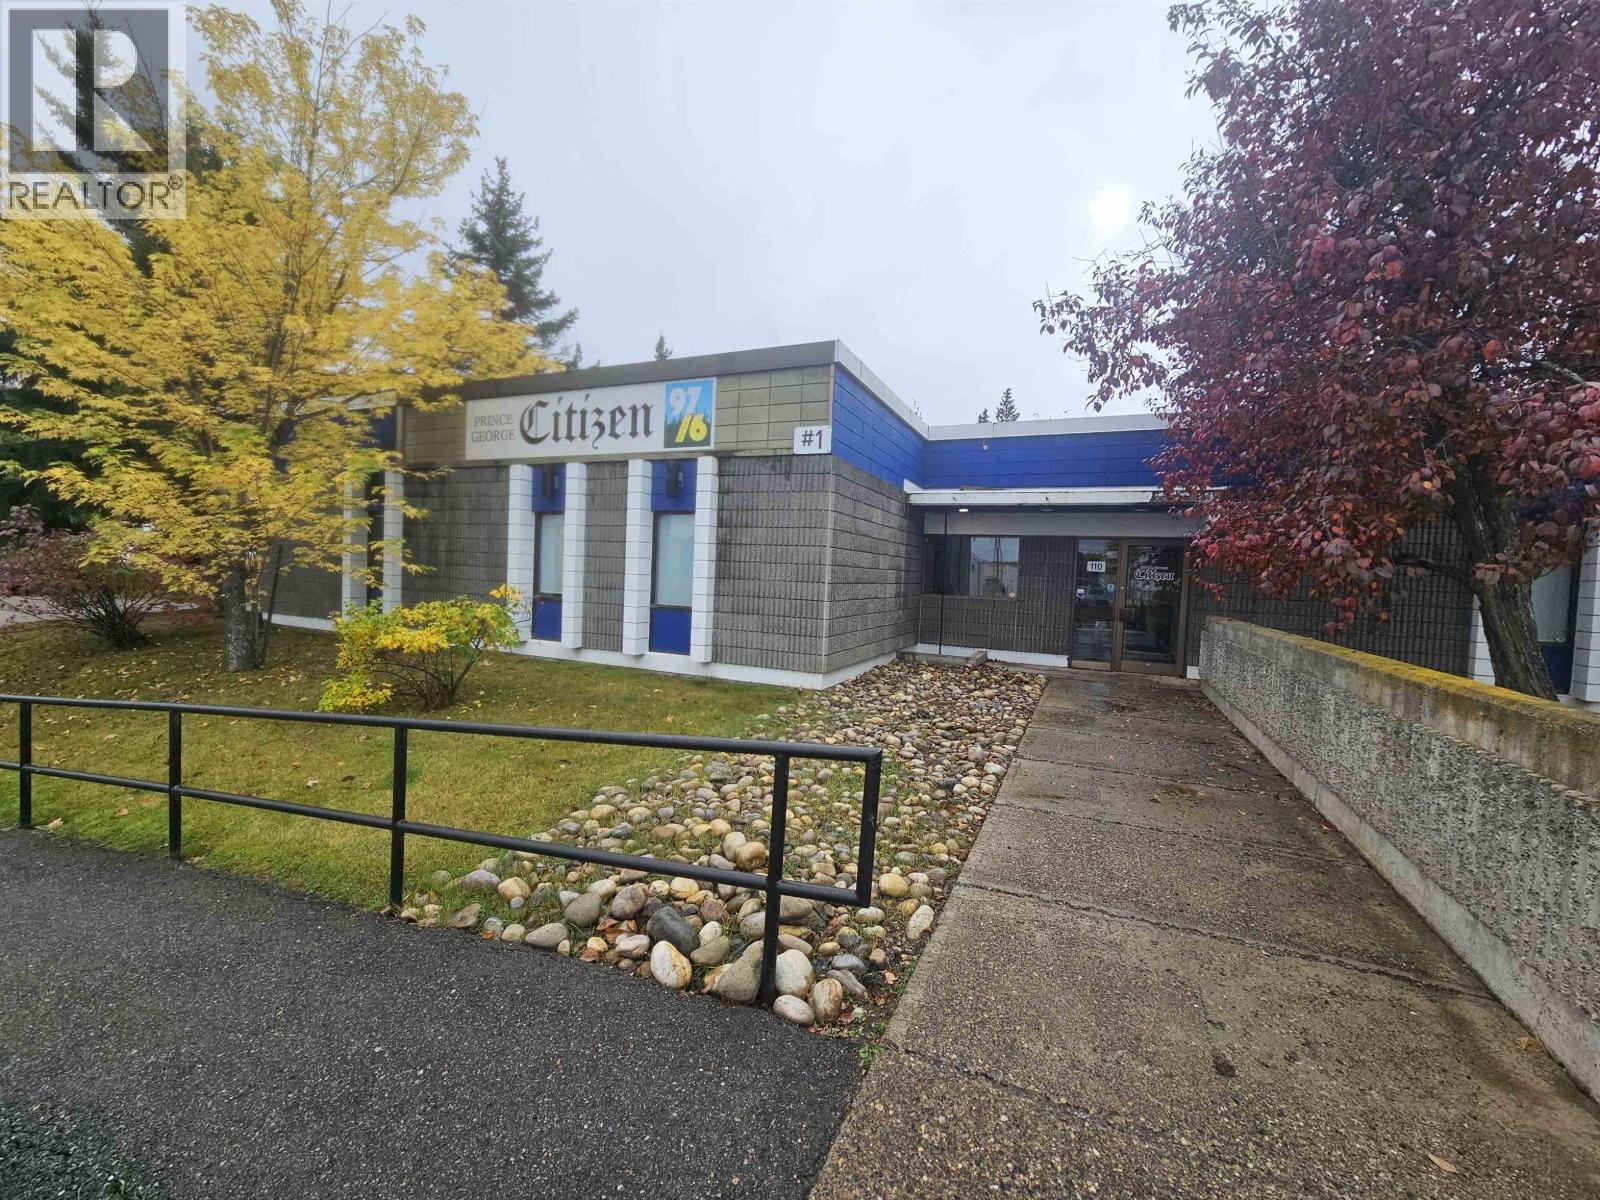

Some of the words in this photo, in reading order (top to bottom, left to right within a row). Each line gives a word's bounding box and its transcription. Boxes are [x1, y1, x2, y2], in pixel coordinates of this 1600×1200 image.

[670, 387, 702, 415] 97
[473, 413, 514, 427] PRINCE
[519, 394, 653, 449] Citizen
[471, 429, 516, 443] GEORGE
[801, 430, 823, 449] #1
[1090, 562, 1103, 571] 110
